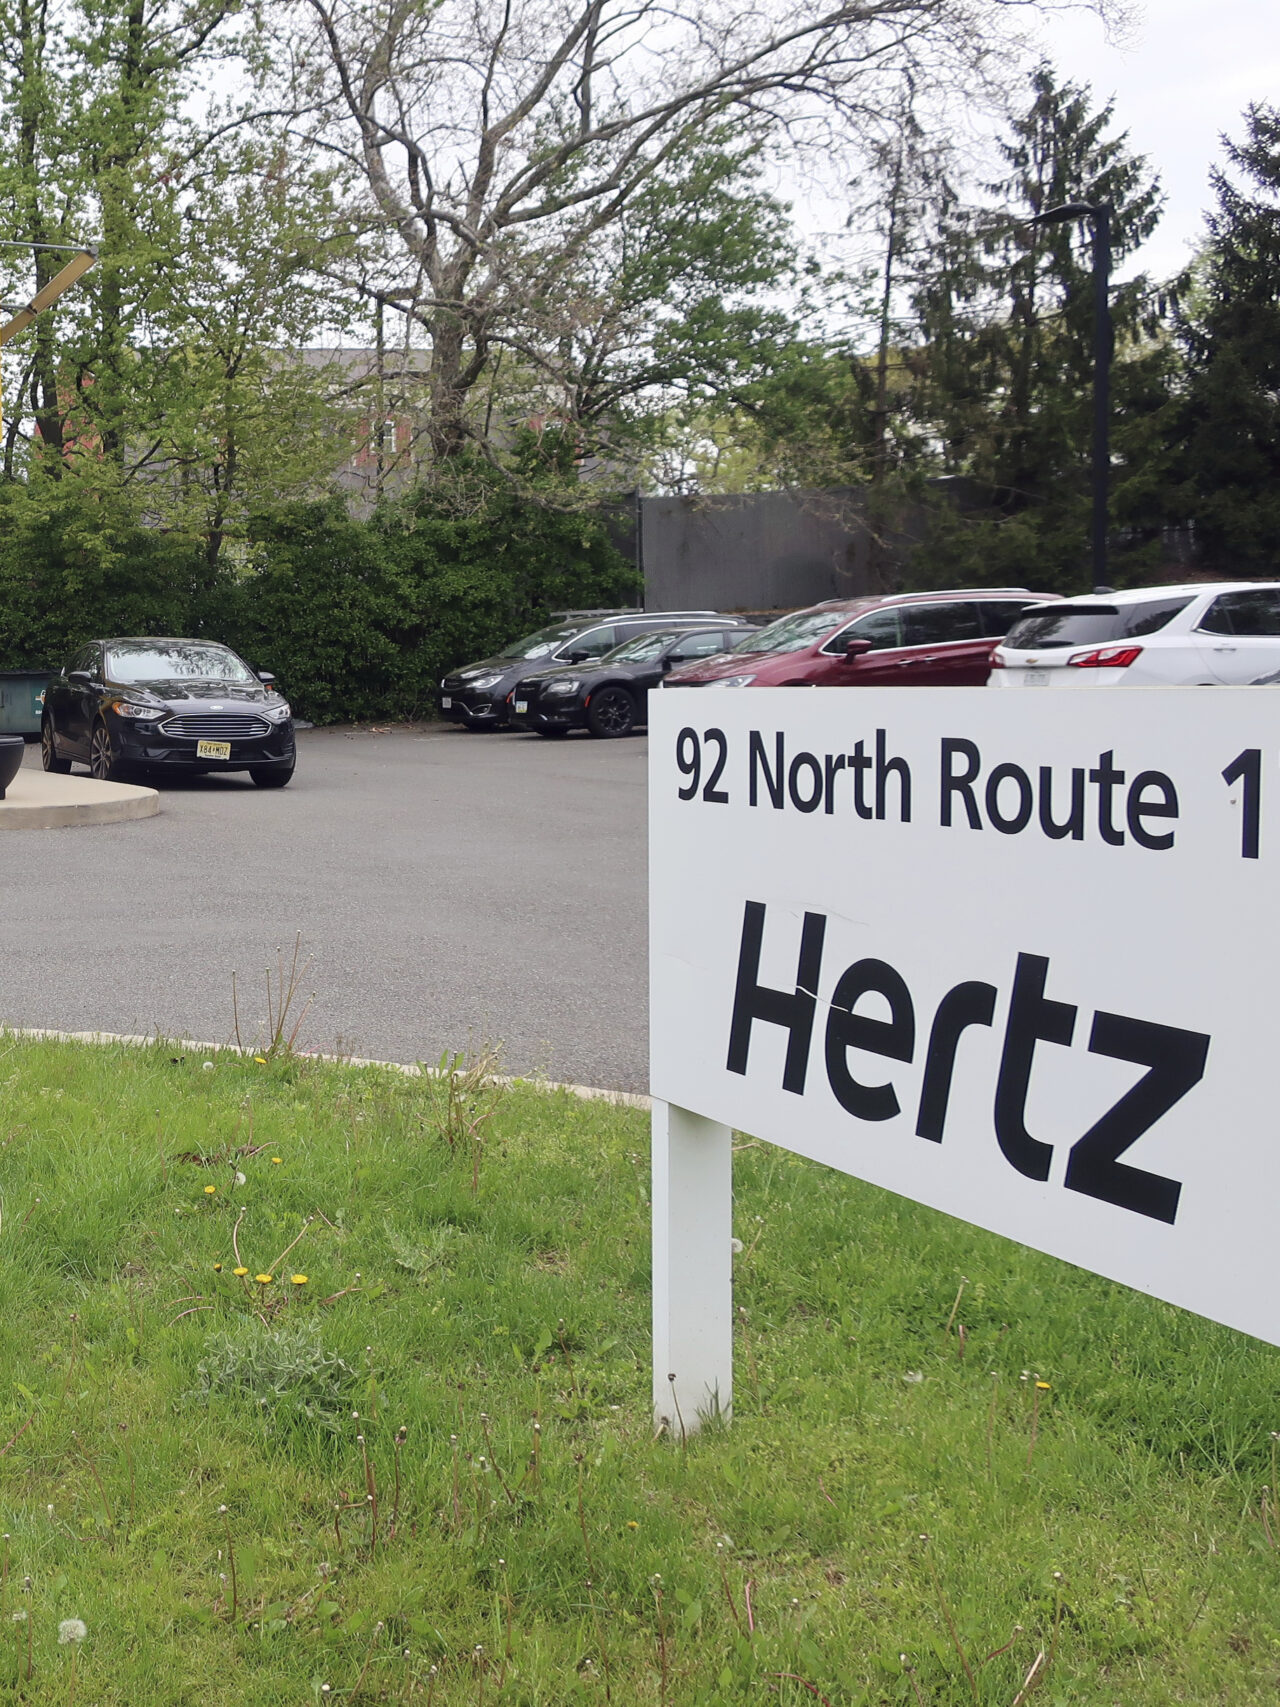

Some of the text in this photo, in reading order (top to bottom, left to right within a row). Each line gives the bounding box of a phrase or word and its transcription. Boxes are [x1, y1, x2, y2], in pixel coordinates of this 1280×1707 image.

[675, 727, 1261, 859] 92 North Route 1
[726, 900, 1211, 1225] Hertz
